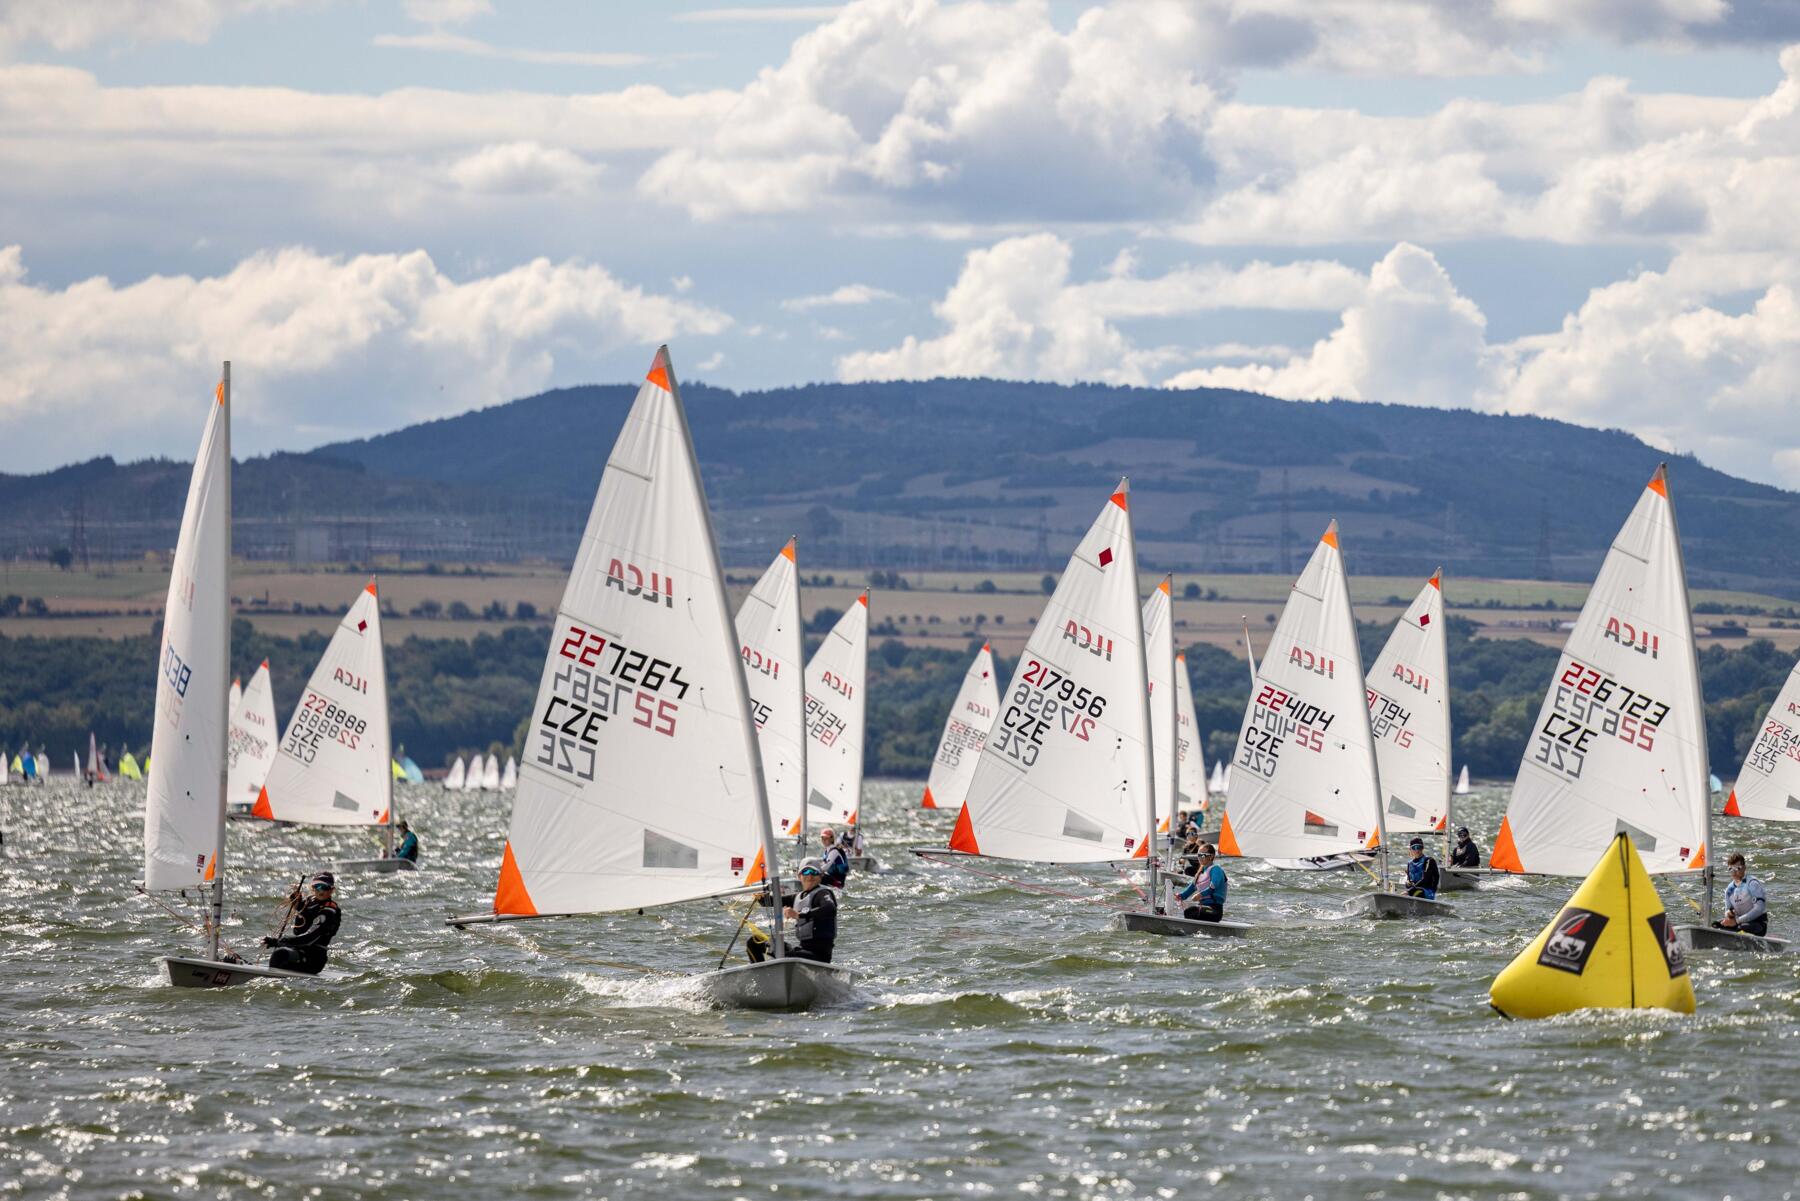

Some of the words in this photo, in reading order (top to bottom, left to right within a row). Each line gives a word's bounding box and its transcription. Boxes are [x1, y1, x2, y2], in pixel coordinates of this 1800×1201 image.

[559, 626, 690, 699] 227264
[1022, 660, 1107, 718] 217956
[1256, 685, 1335, 731] 224104
[1561, 661, 1671, 727] 226723
[304, 693, 367, 735] 228888
[542, 696, 608, 745] CZE
[1003, 706, 1050, 746] CZE
[1542, 712, 1598, 753] CZE
[1765, 720, 1800, 747] 2254
[291, 723, 324, 750] CZE
[943, 741, 964, 757] CZE
[1245, 726, 1284, 758] CZE
[1754, 742, 1781, 763] CZE
